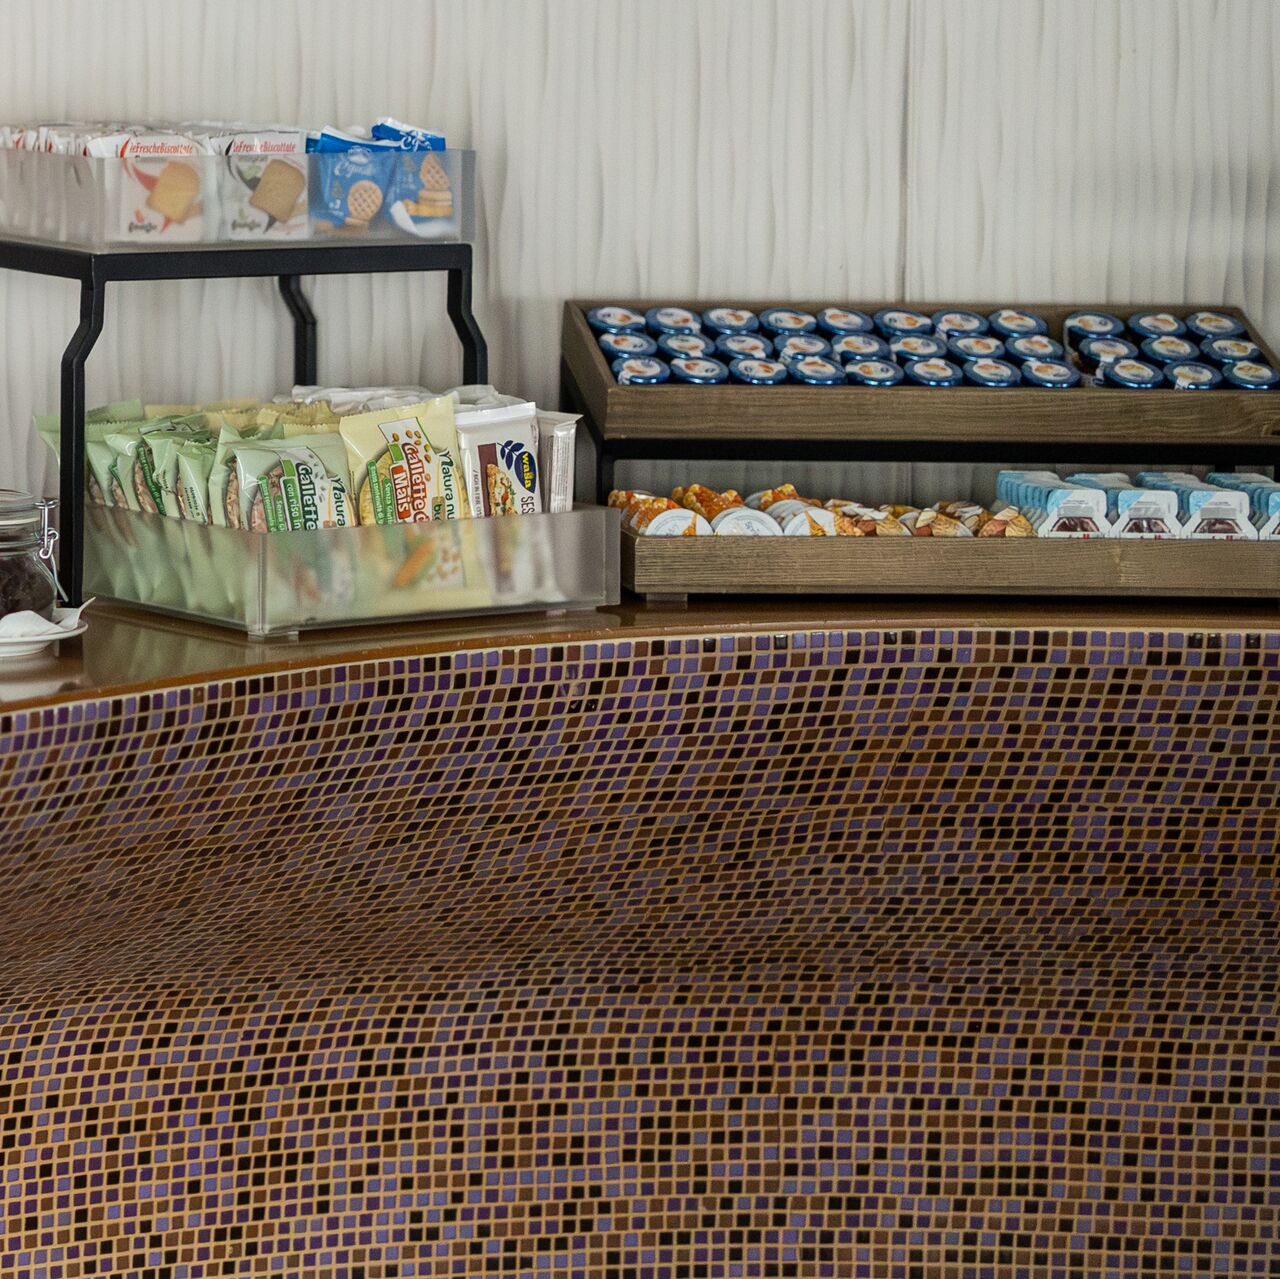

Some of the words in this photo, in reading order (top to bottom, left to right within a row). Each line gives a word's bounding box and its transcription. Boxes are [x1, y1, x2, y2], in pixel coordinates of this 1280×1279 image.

[393, 470, 410, 513] Mais
[401, 442, 427, 511] Gallette
[439, 447, 455, 501] Natura
[522, 452, 535, 489] wasa
[290, 501, 299, 517] riso
[296, 462, 318, 531] Gallette
[332, 475, 346, 527] Natura
[521, 495, 536, 515] SES
